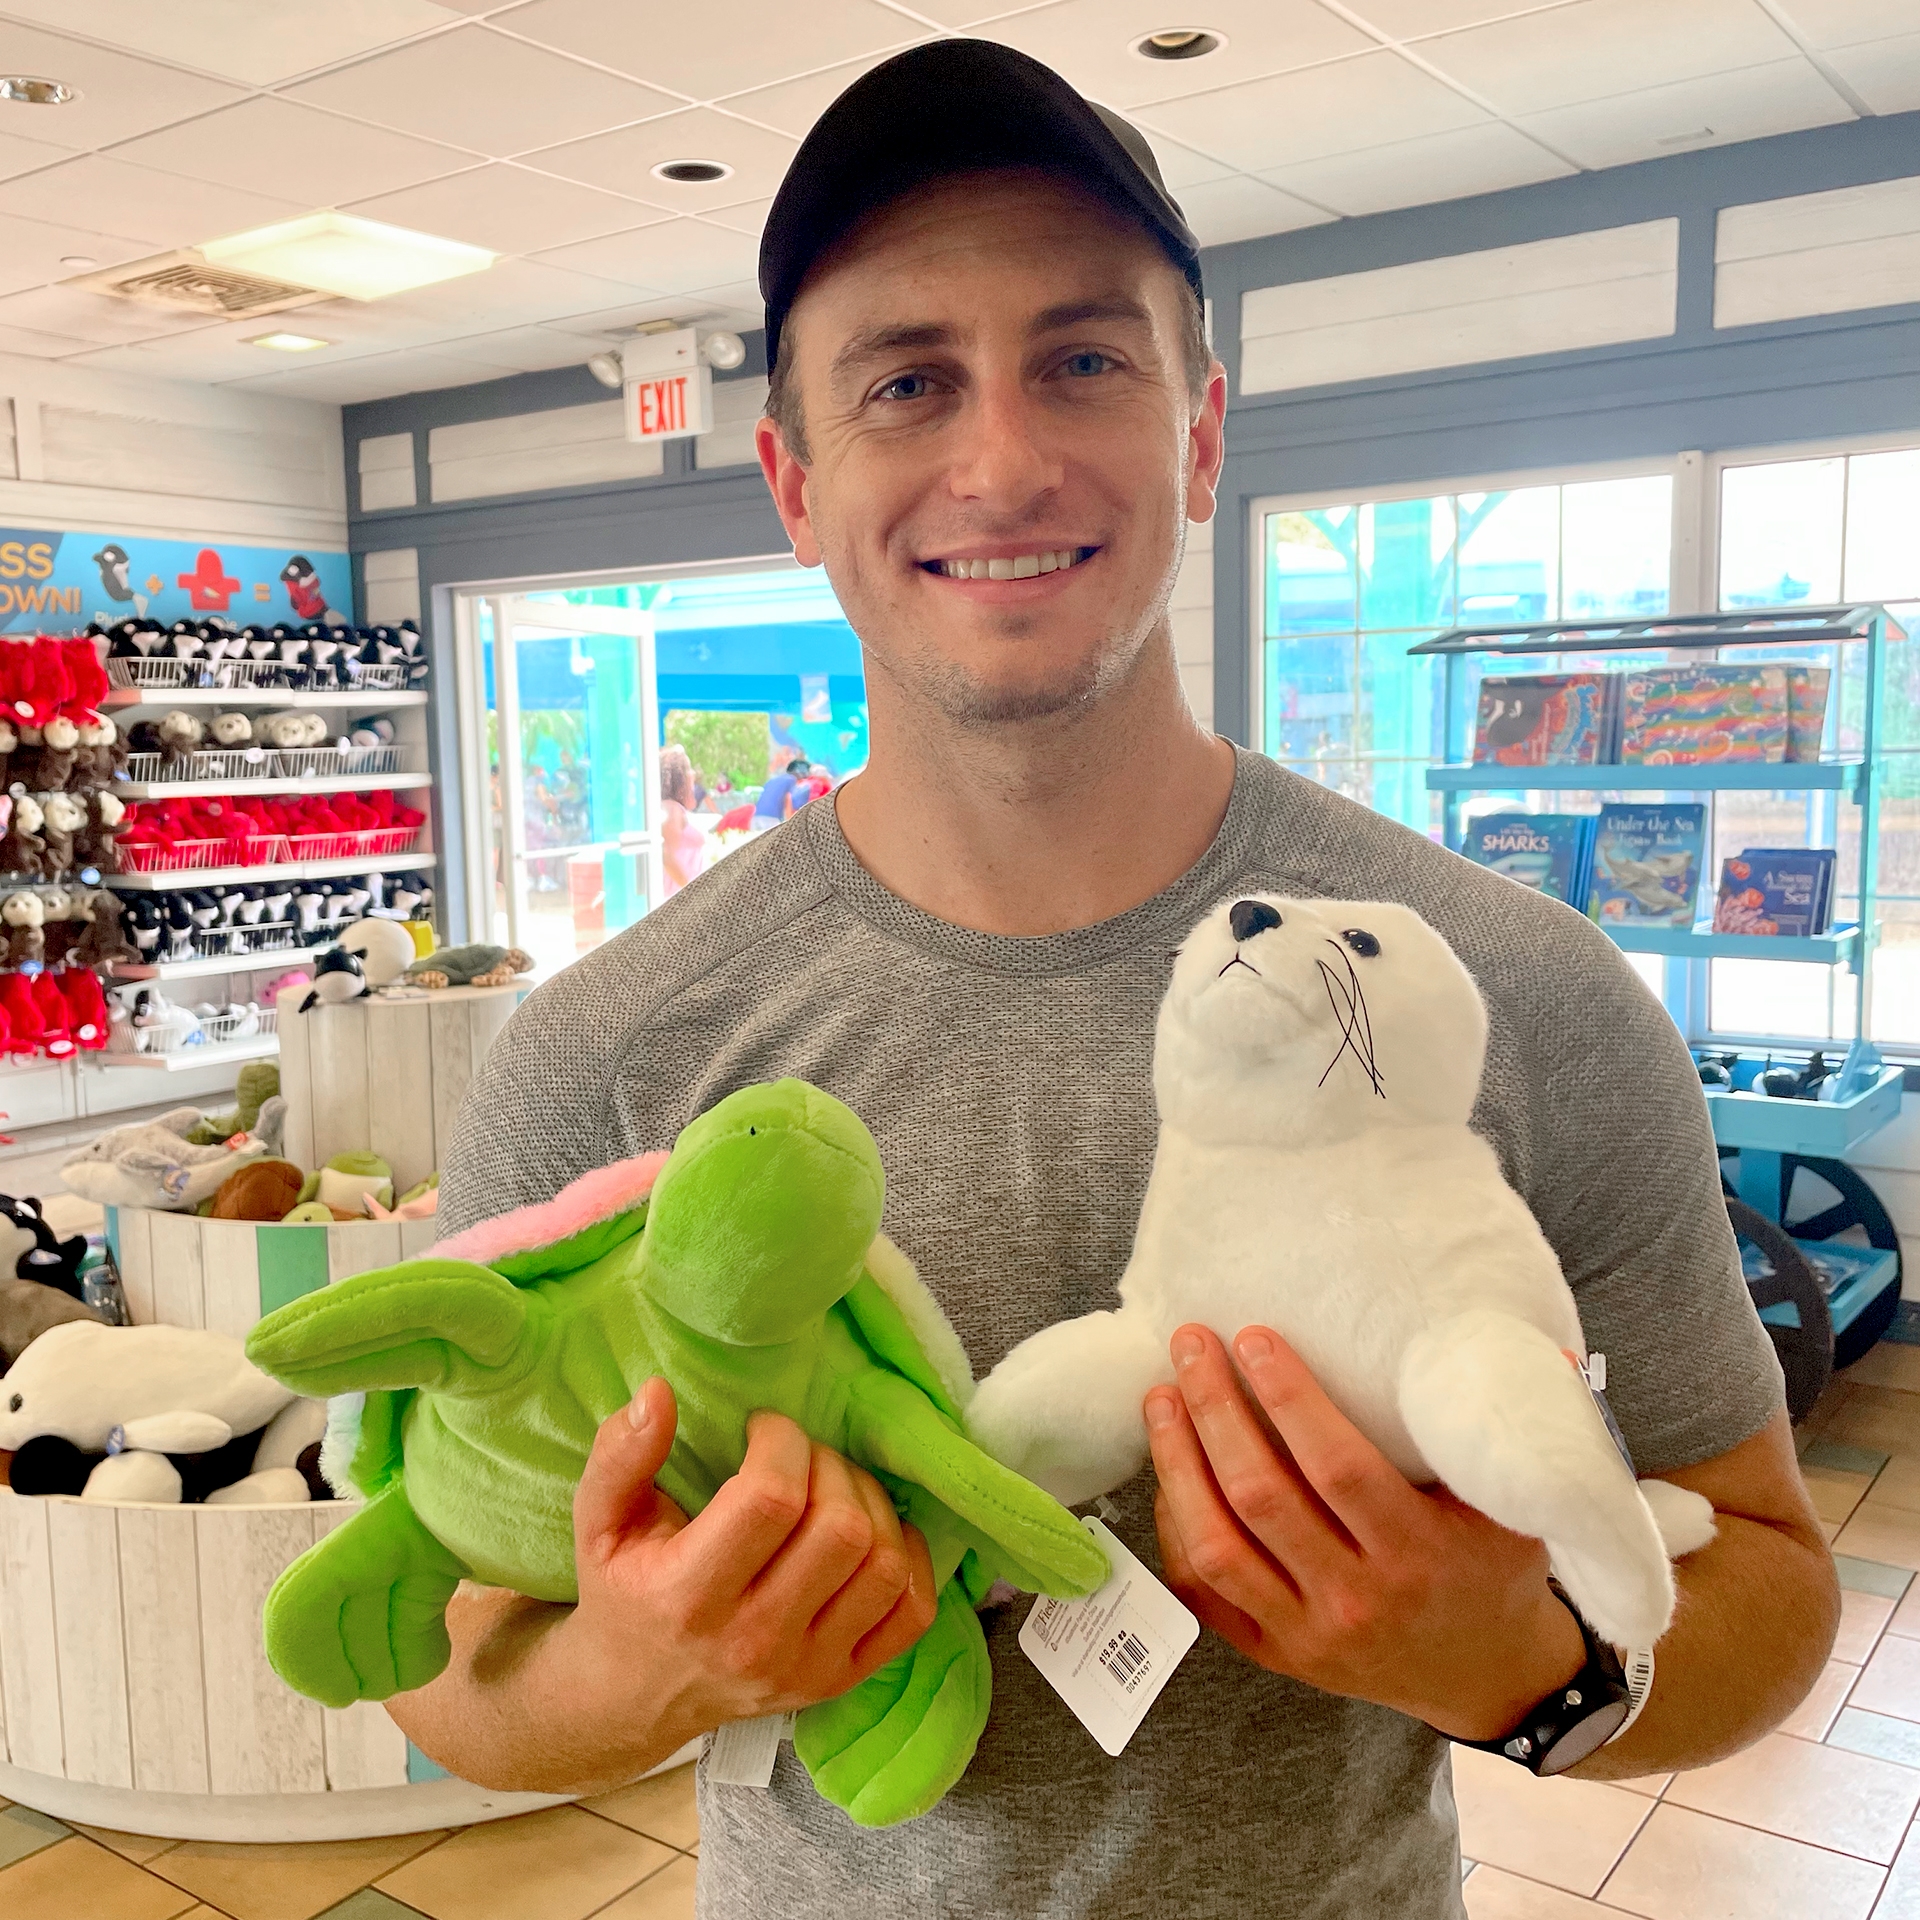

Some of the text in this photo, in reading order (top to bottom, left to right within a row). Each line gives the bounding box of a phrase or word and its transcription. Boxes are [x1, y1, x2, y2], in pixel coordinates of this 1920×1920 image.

[639, 377, 687, 435] EXIT
[1607, 814, 1695, 832] Under the Sea
[1482, 834, 1549, 852] SHARKS
[1099, 1638, 1118, 1665] $19.99
[1117, 1629, 1127, 1641] ea
[1126, 1660, 1153, 1694] 00437697
